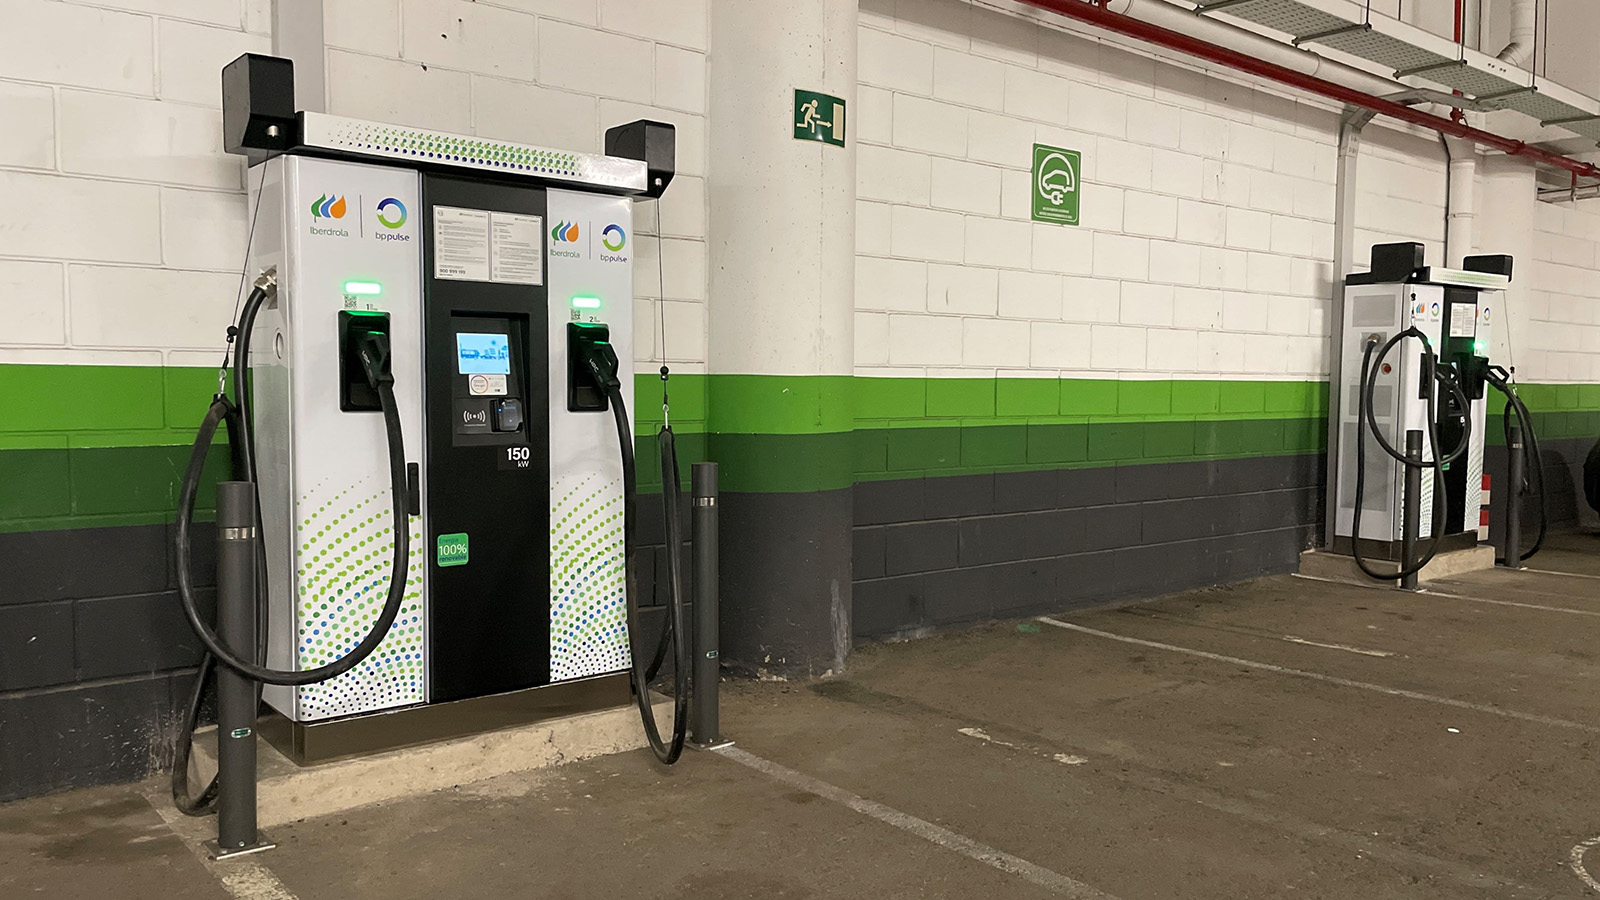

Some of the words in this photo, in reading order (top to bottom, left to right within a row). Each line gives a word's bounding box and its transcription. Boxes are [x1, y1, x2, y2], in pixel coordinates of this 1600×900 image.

[310, 227, 349, 237] Iberdrola
[550, 249, 580, 259] Iberdrola
[507, 447, 530, 461] 150
[517, 460, 530, 468] kW
[439, 544, 467, 556] 100%
